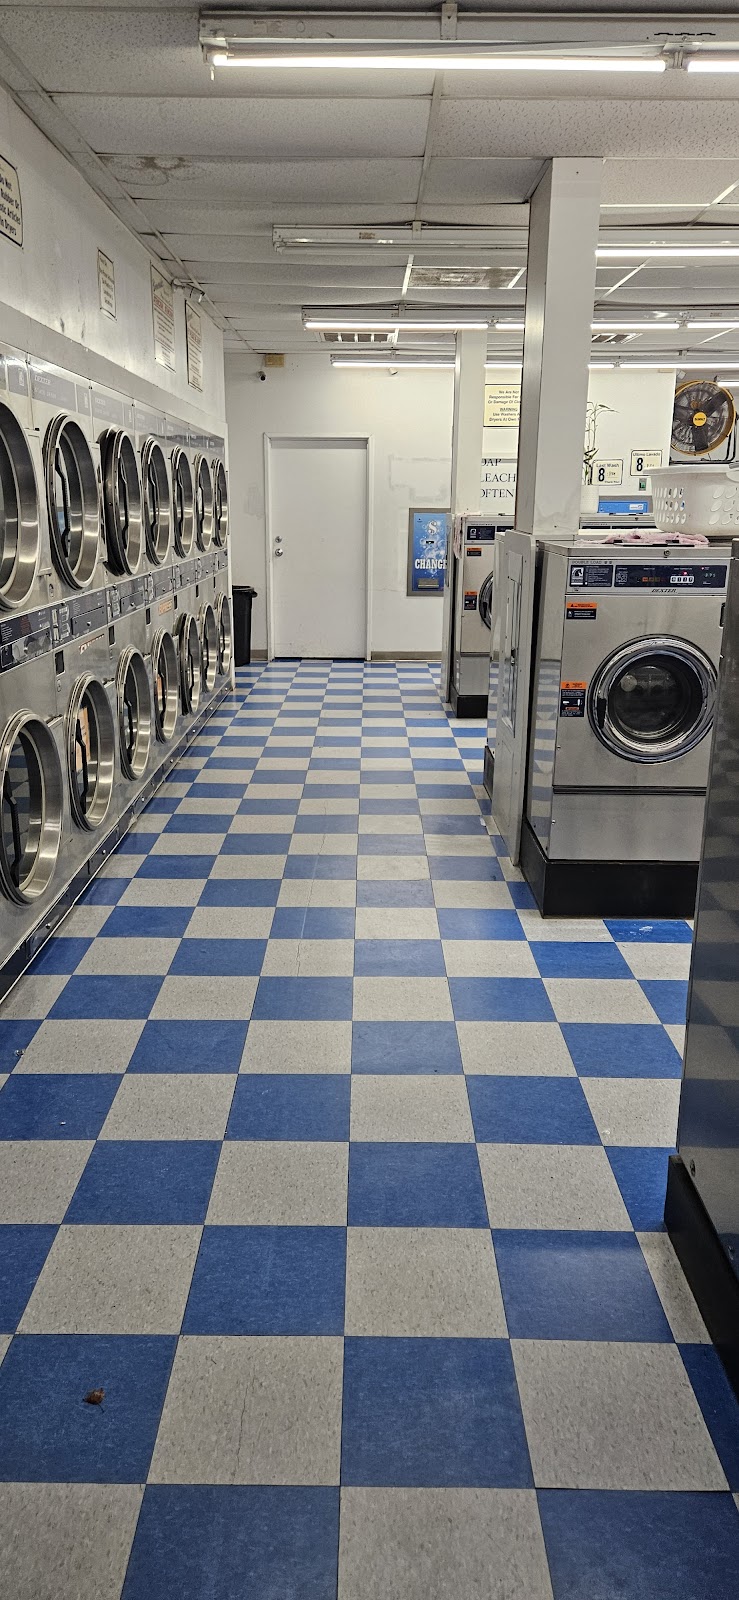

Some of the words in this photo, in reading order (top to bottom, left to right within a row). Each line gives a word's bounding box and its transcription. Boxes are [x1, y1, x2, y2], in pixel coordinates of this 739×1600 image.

[636, 457, 644, 471] 8
[598, 467, 605, 482] 8
[414, 558, 448, 570] CHANGE
